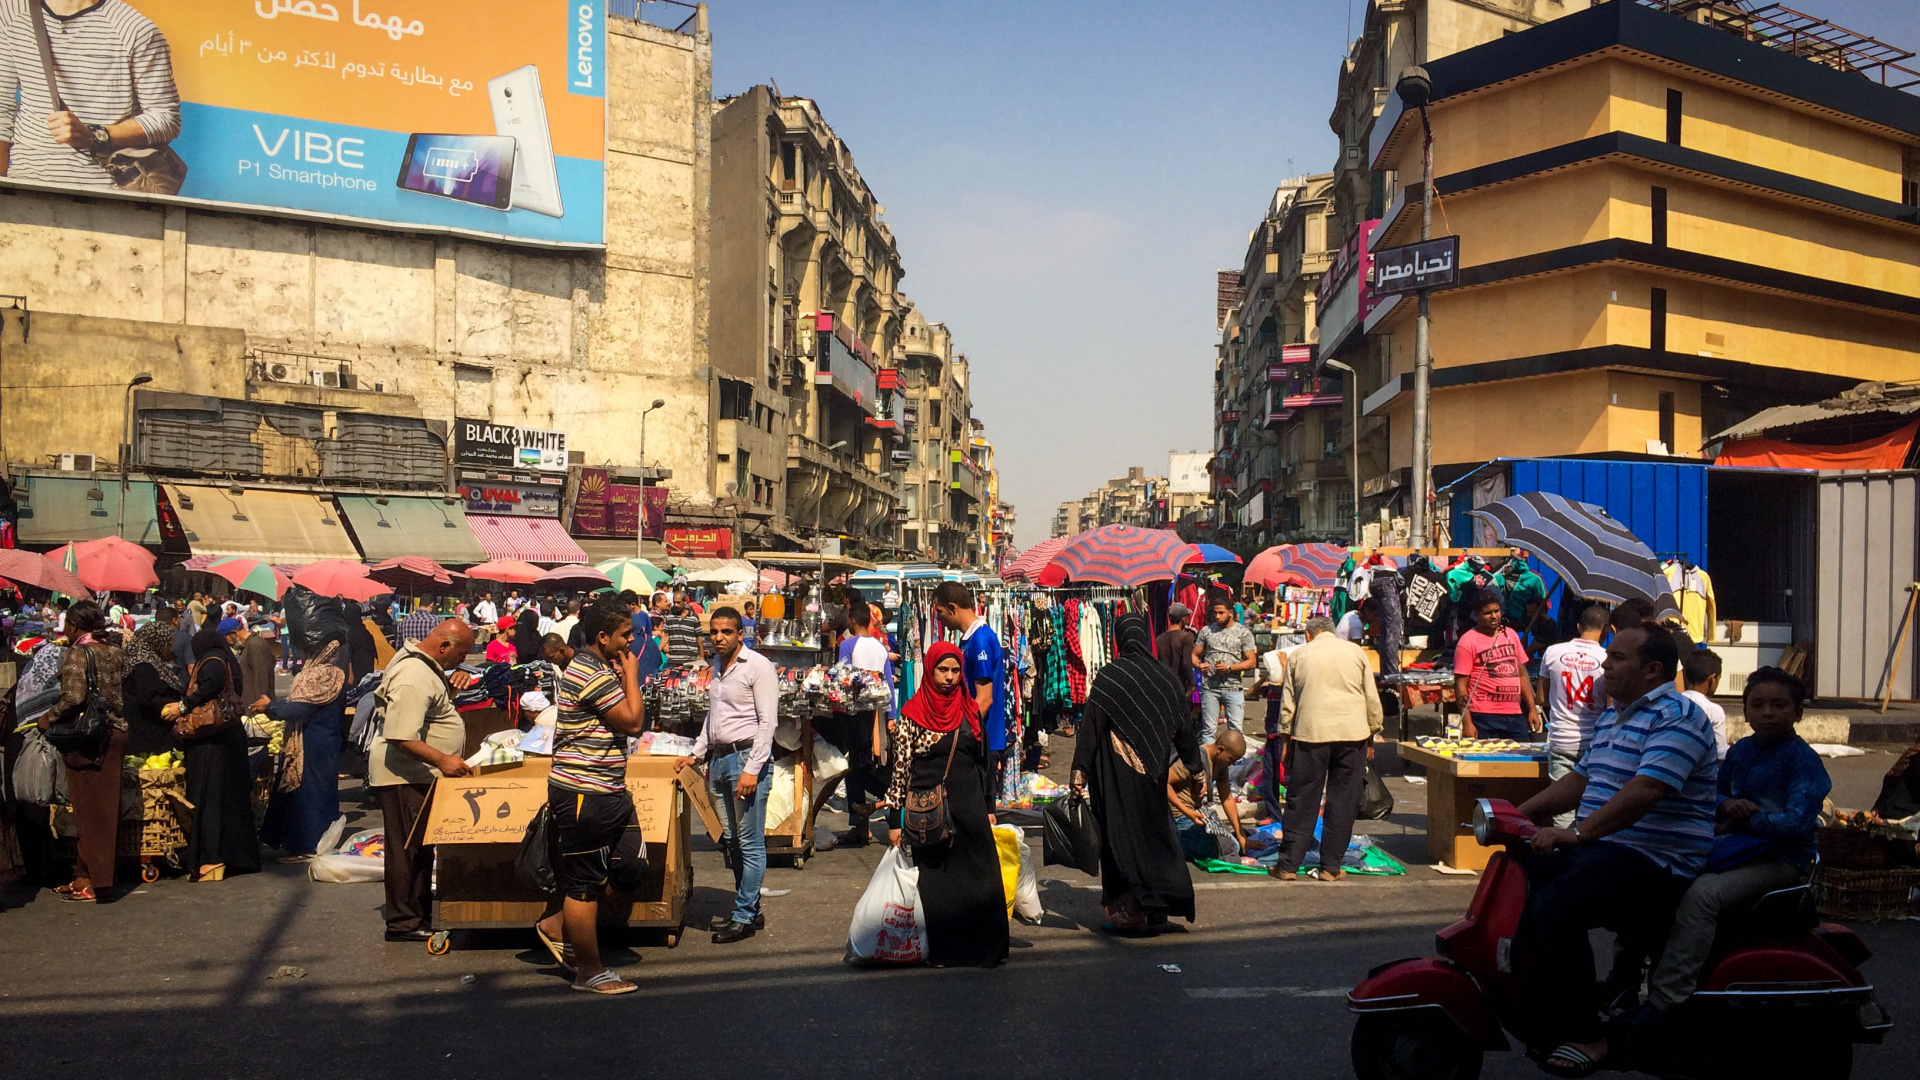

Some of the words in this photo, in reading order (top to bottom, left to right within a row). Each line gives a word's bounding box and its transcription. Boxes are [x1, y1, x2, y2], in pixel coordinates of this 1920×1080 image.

[352, 0, 425, 41] مهما
[199, 30, 234, 57] أيام
[239, 39, 252, 54] ٣
[257, 47, 287, 64] من
[574, 4, 593, 88] Lenovo
[293, 50, 336, 69] لأكتر
[341, 62, 385, 80] تدوم
[390, 62, 443, 90] بطارية
[448, 79, 474, 97] مع
[252, 123, 364, 169] VIBE
[238, 159, 260, 177] P1
[268, 163, 377, 192] Smartphone
[1377, 262, 1413, 288] مصر
[1413, 250, 1452, 281] تحيا
[466, 423, 511, 445] BLACK
[511, 428, 521, 447] &
[522, 429, 566, 451] WHITE
[671, 533, 717, 544] الحرمين
[1410, 575, 1429, 606] WHO
[1561, 670, 1595, 711] 14
